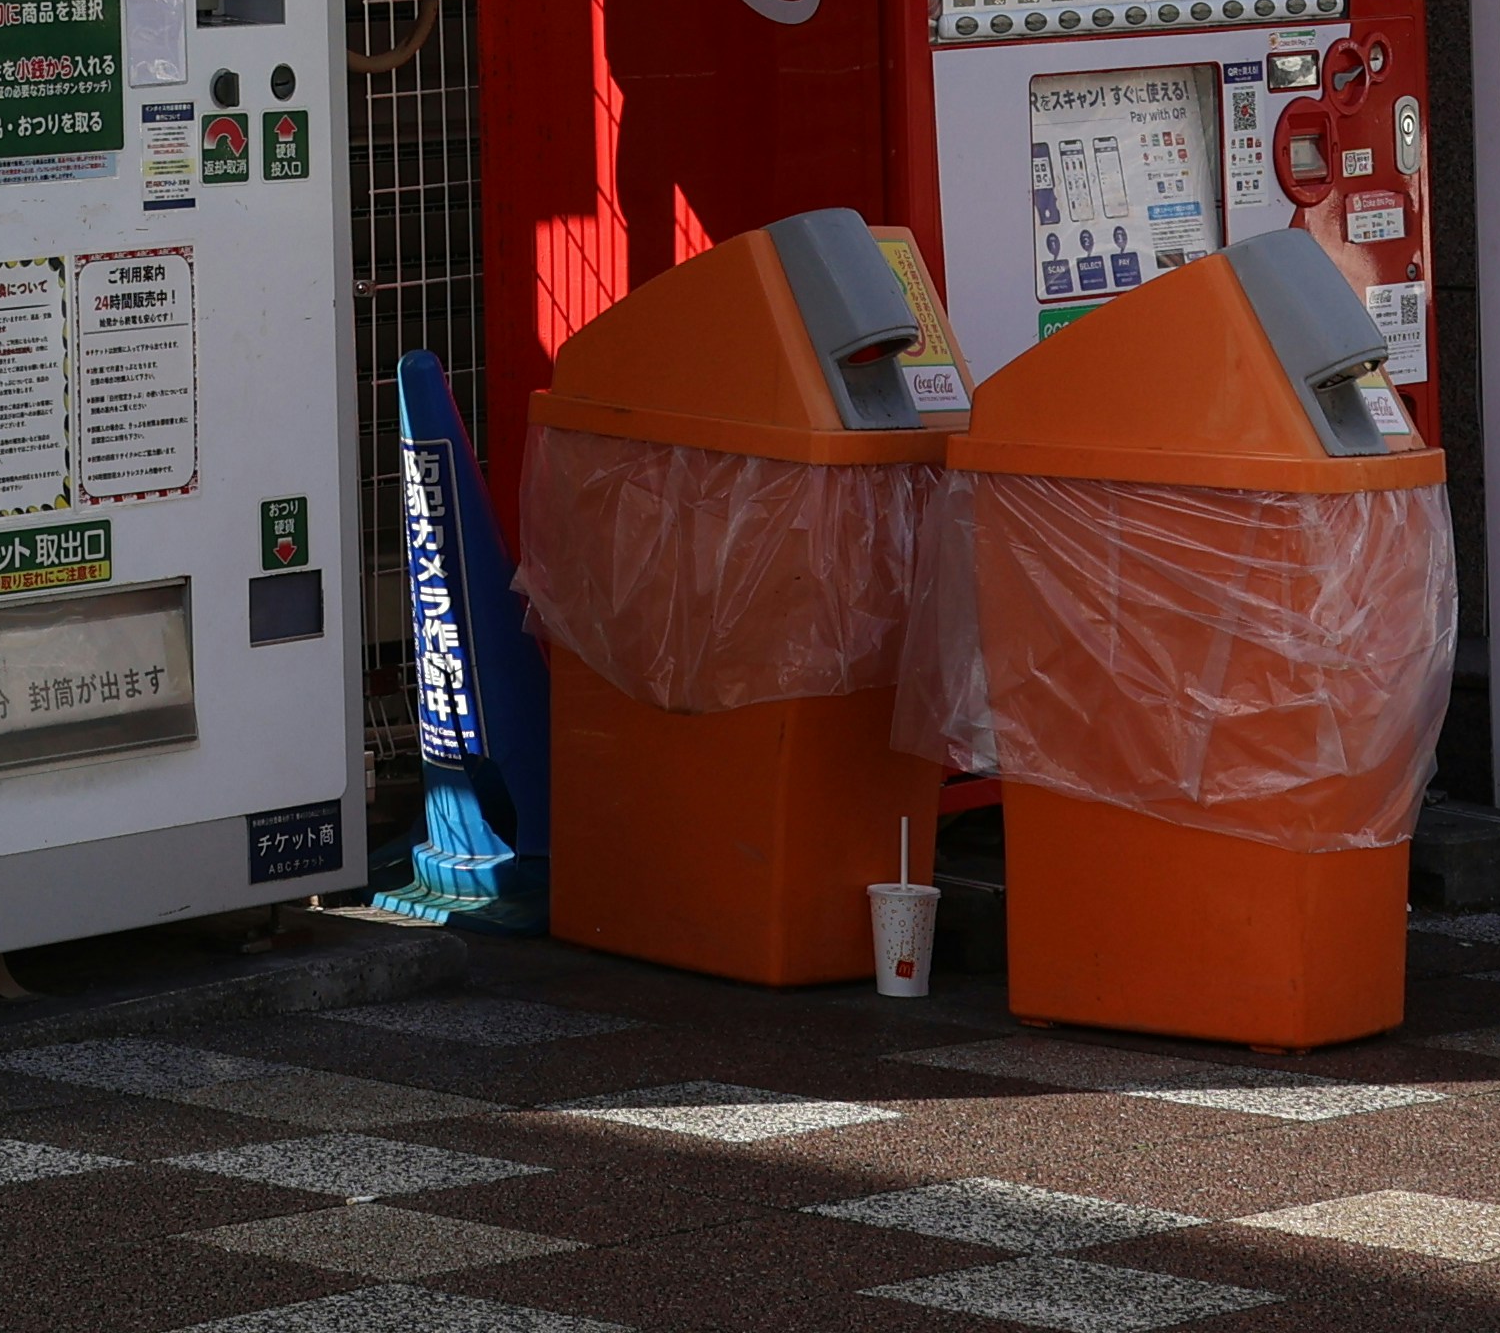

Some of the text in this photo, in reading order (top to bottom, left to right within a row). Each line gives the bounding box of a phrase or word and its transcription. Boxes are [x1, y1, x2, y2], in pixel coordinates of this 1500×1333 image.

[1110, 80, 1190, 105] すぐに使える!
[1130, 107, 1187, 125] Pay with QR
[275, 143, 296, 159] 硬貨
[270, 161, 302, 177] 投入口
[1358, 161, 1369, 172] OK
[107, 263, 166, 285] ご利用案内
[1047, 258, 1131, 274] SCAN SELECT PAY
[913, 373, 954, 395] Coca-Cola
[268, 499, 299, 518] おつり
[35, 528, 105, 567] 取出口
[402, 449, 470, 723] 防犯カメラ作動中
[28, 664, 166, 713] 封筒が出ます
[257, 823, 335, 857] チケット商
